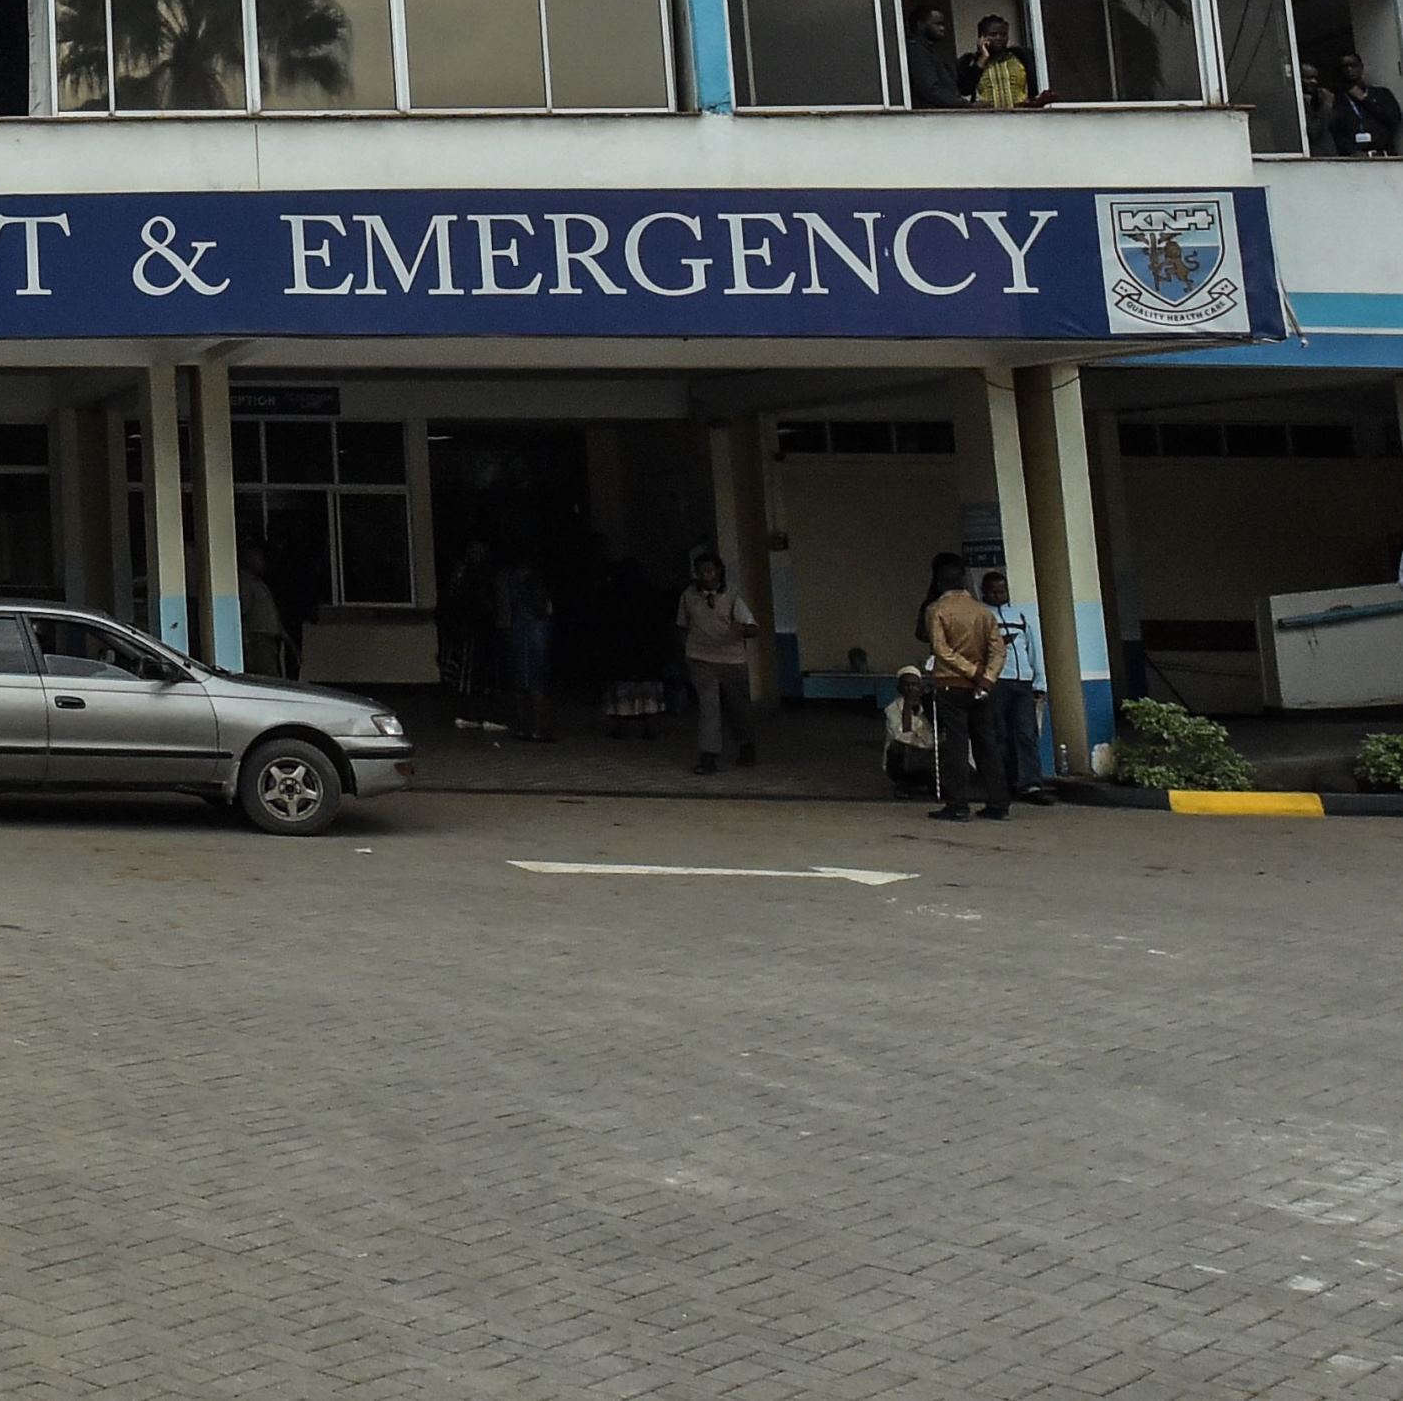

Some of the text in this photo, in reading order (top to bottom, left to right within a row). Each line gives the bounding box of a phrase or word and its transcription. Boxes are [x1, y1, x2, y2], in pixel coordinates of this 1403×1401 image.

[132, 214, 231, 296] &
[279, 210, 1058, 296] EMERGENCY
[1126, 301, 1226, 322] QUALITY HEALTH CARE
[231, 395, 277, 407] EPTION
